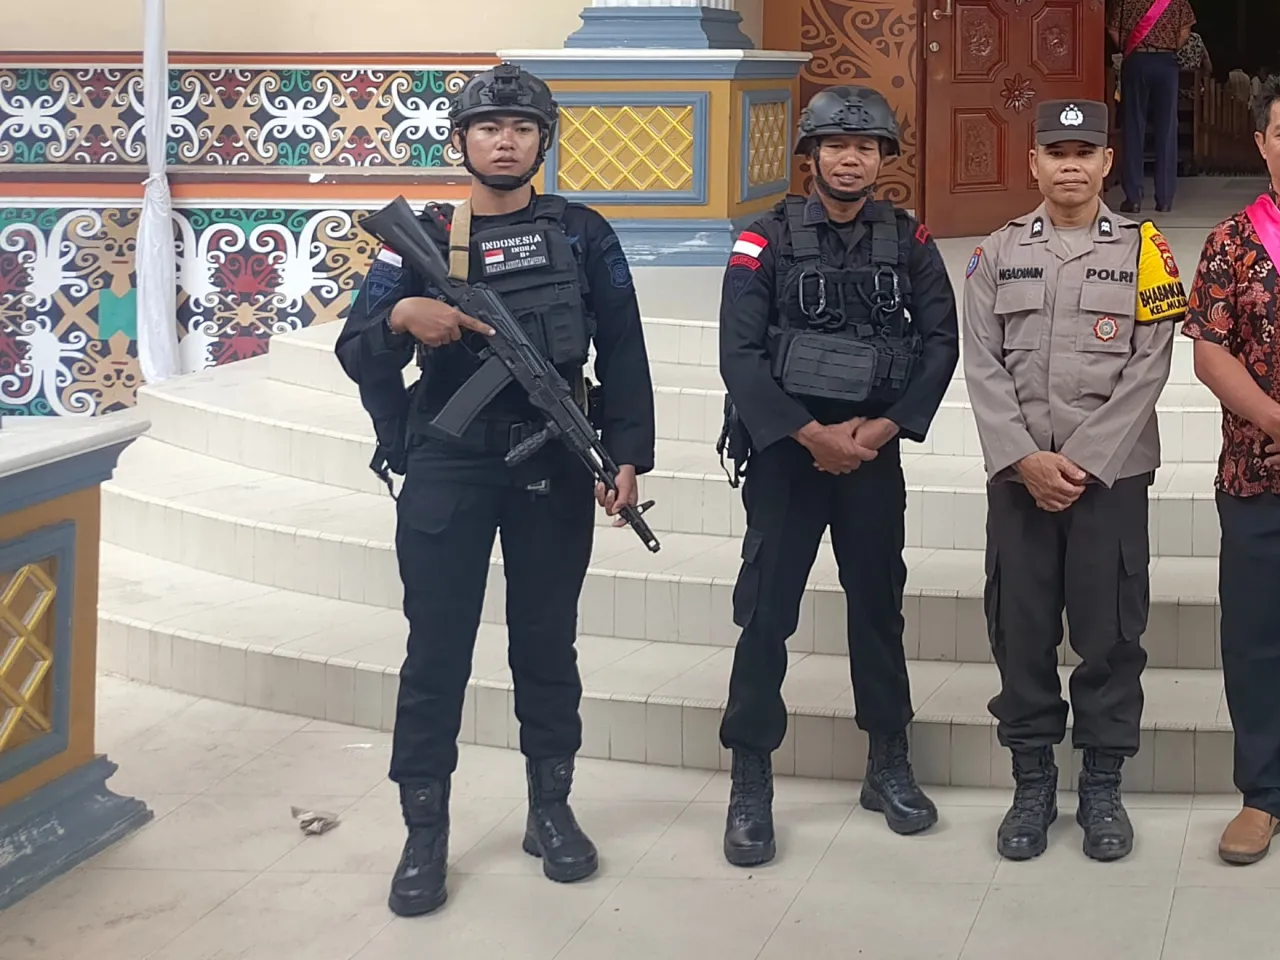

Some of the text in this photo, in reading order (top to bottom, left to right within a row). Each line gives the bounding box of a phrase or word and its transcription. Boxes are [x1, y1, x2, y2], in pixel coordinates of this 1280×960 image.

[481, 234, 542, 250] INDONESIA
[999, 267, 1044, 280] NGADIMIN
[1086, 268, 1134, 283] POLRI
